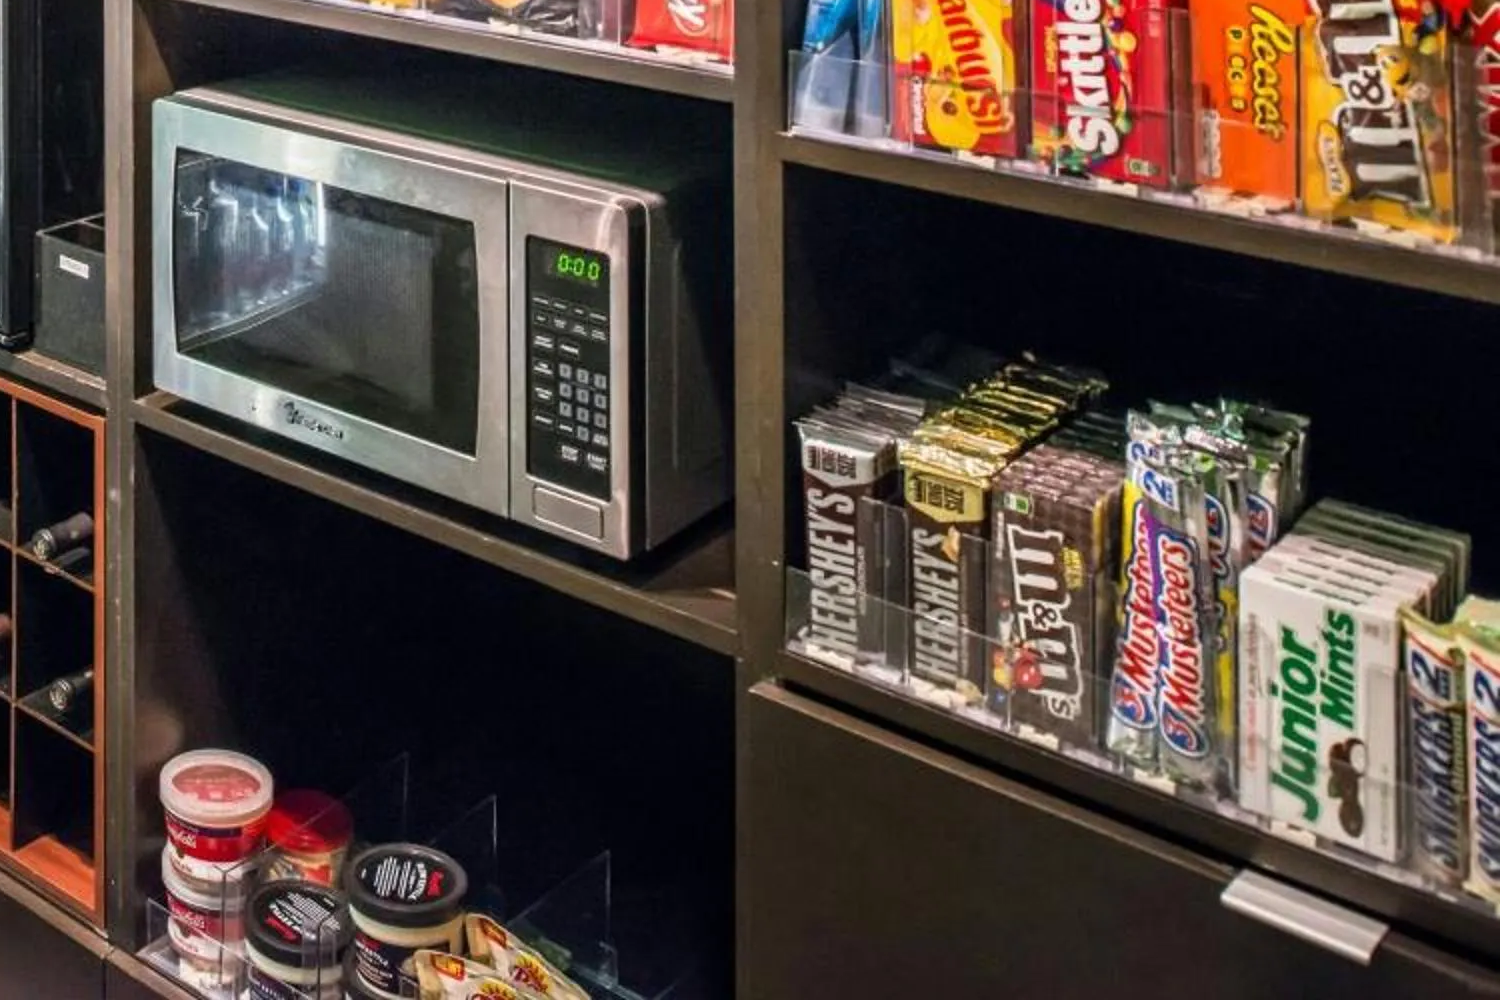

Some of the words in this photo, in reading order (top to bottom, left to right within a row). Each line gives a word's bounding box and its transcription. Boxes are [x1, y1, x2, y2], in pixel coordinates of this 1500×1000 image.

[558, 254, 601, 281] 0:00
[806, 487, 857, 655] HERSHEY'S
[912, 526, 961, 688] HERSHEY'S
[1160, 539, 1198, 725] Musketeers
[1272, 625, 1322, 824] Junior
[1321, 607, 1355, 730] Mints
[1411, 651, 1440, 690] 2
